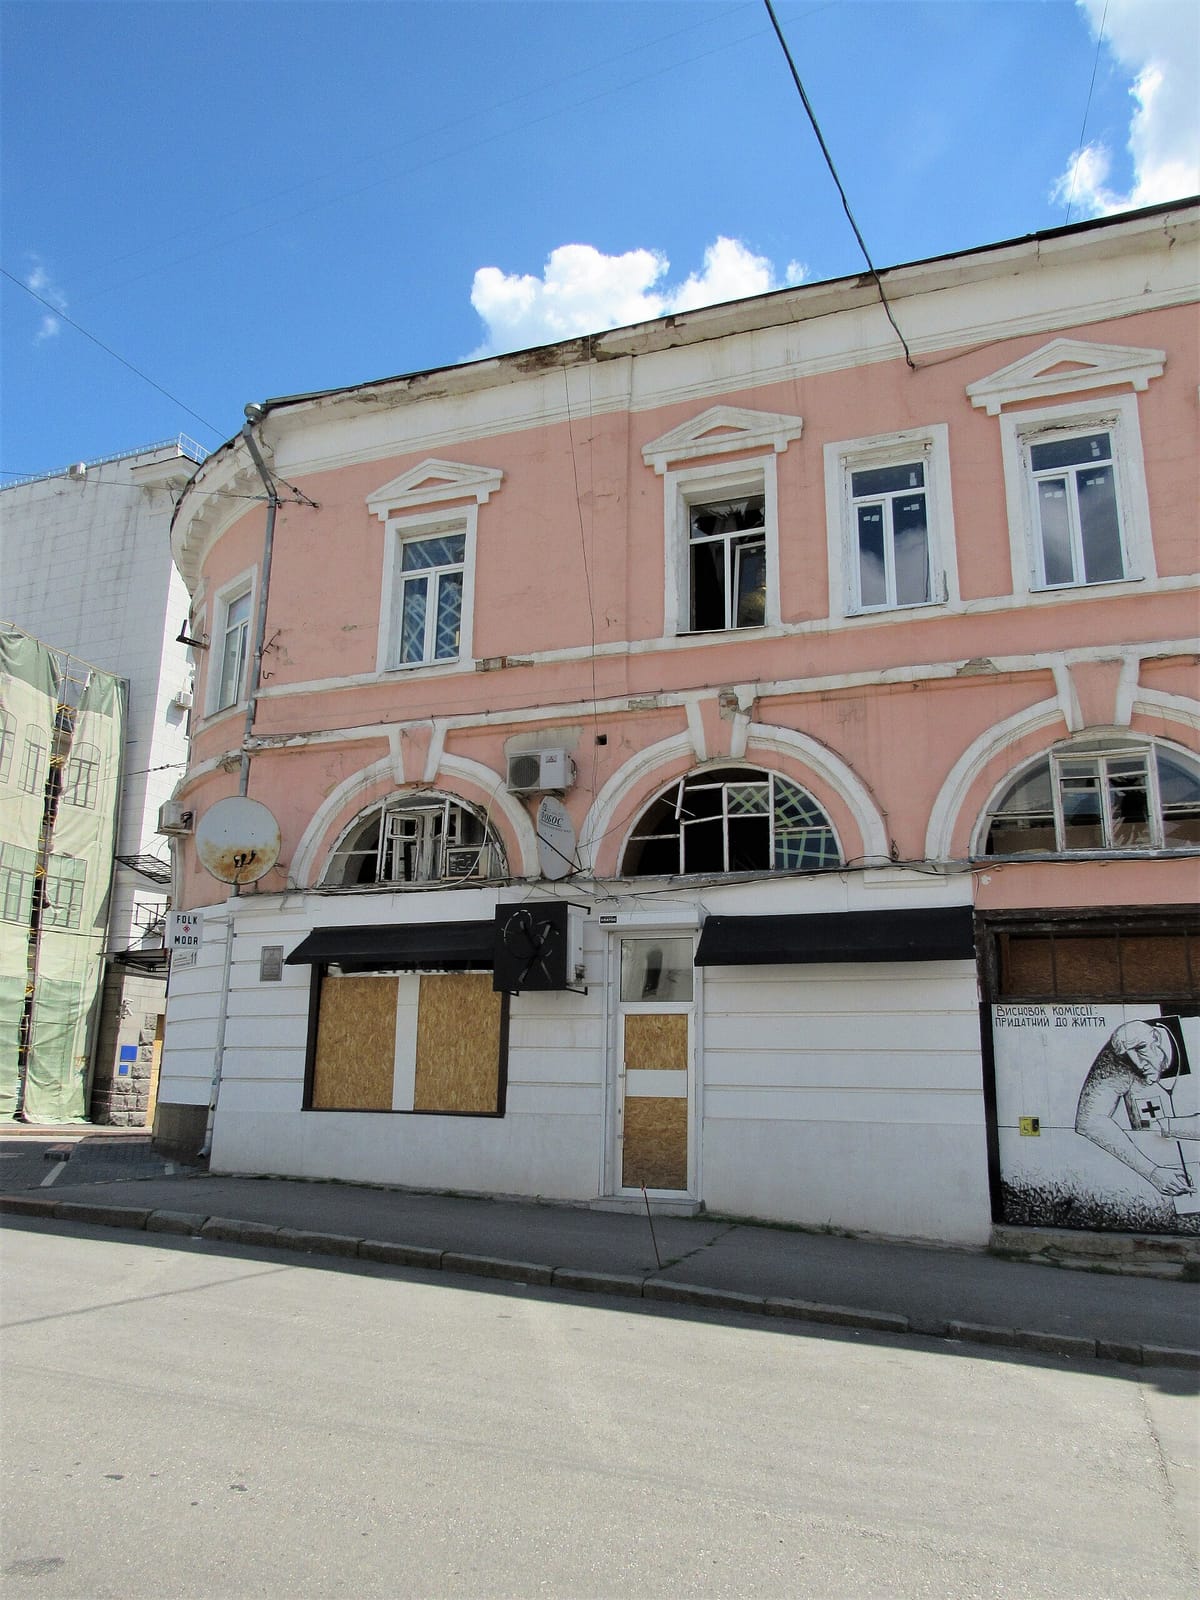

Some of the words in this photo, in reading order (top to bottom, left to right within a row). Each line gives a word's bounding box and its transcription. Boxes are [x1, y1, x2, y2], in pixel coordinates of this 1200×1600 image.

[176, 915, 197, 924] FOLK
[995, 1016, 1050, 1027] ПРИДАТНИЙ
[1054, 1017, 1067, 1027] ДО
[1071, 1016, 1106, 1027] ЖИТТЯ
